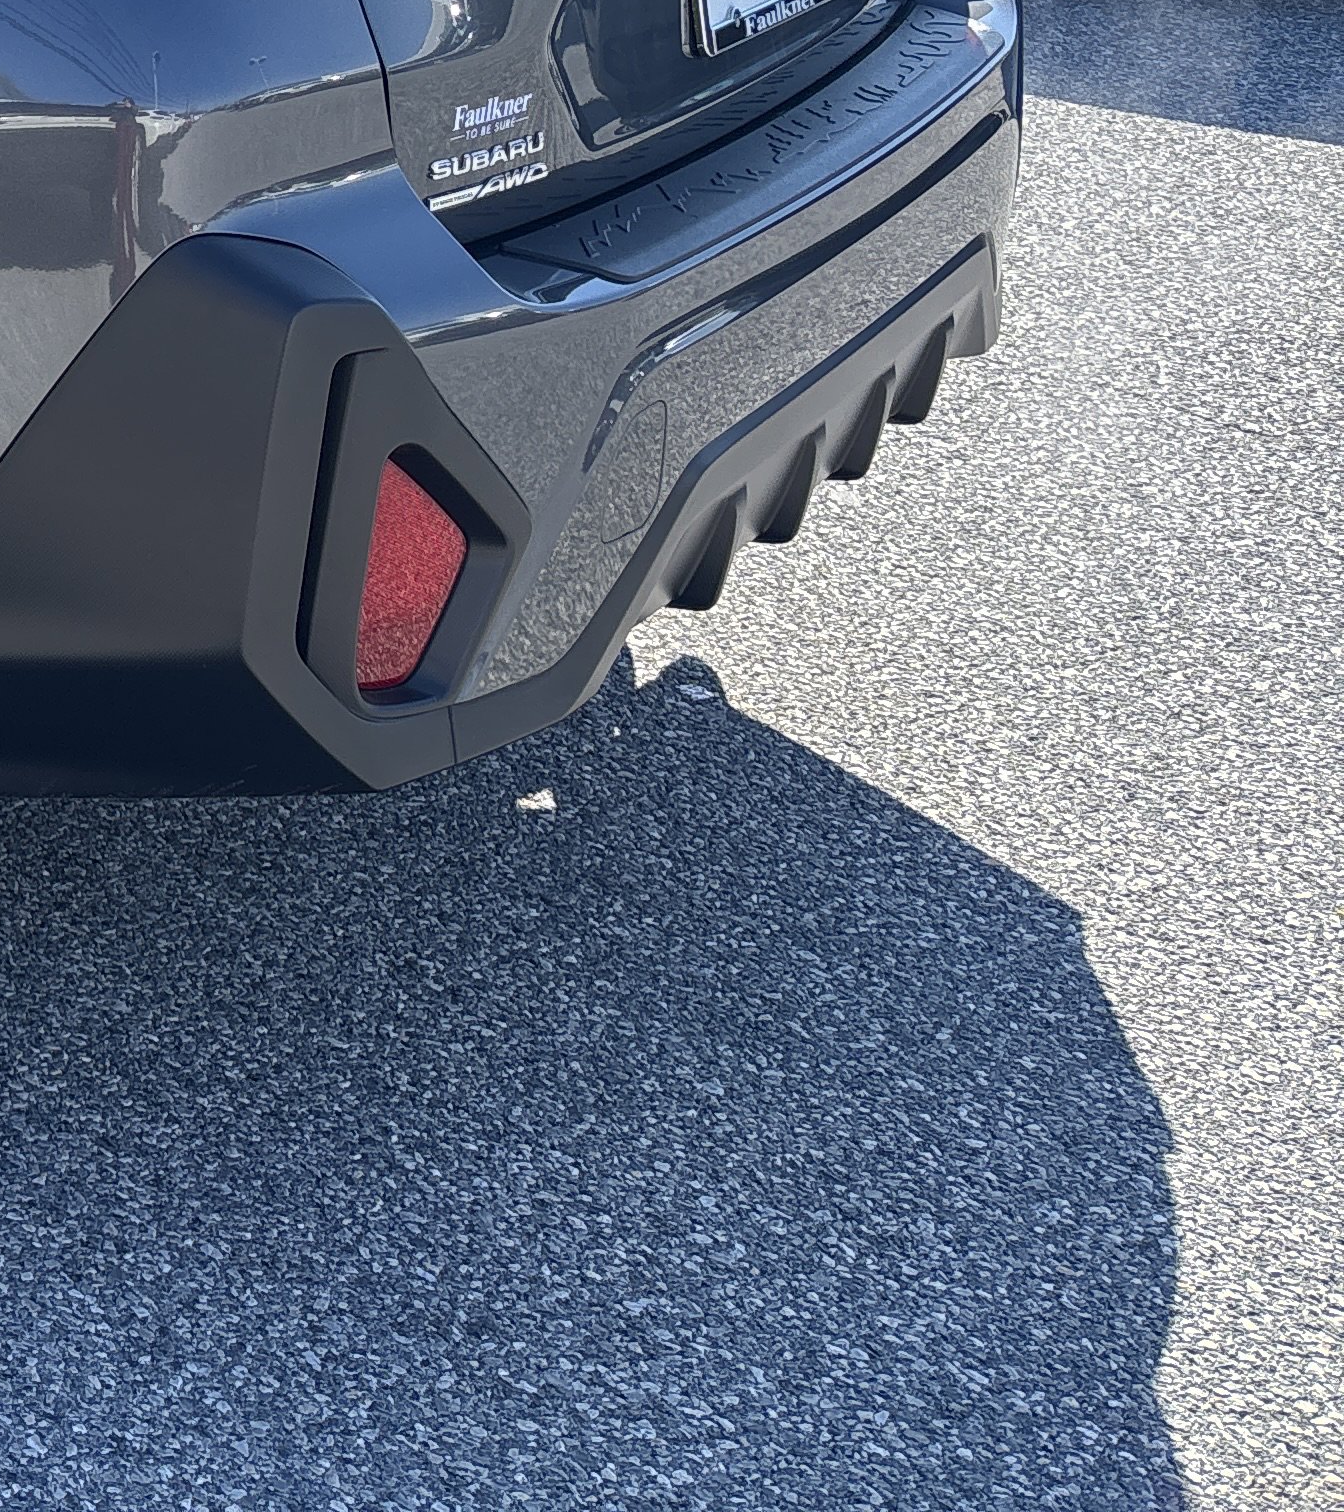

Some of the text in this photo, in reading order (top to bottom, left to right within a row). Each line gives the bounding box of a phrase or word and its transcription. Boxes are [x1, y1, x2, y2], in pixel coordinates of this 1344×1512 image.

[452, 93, 532, 132] Faulkner
[465, 117, 516, 141] TO BE SURE
[430, 131, 545, 180] SUBARU
[476, 162, 549, 198] AWD
